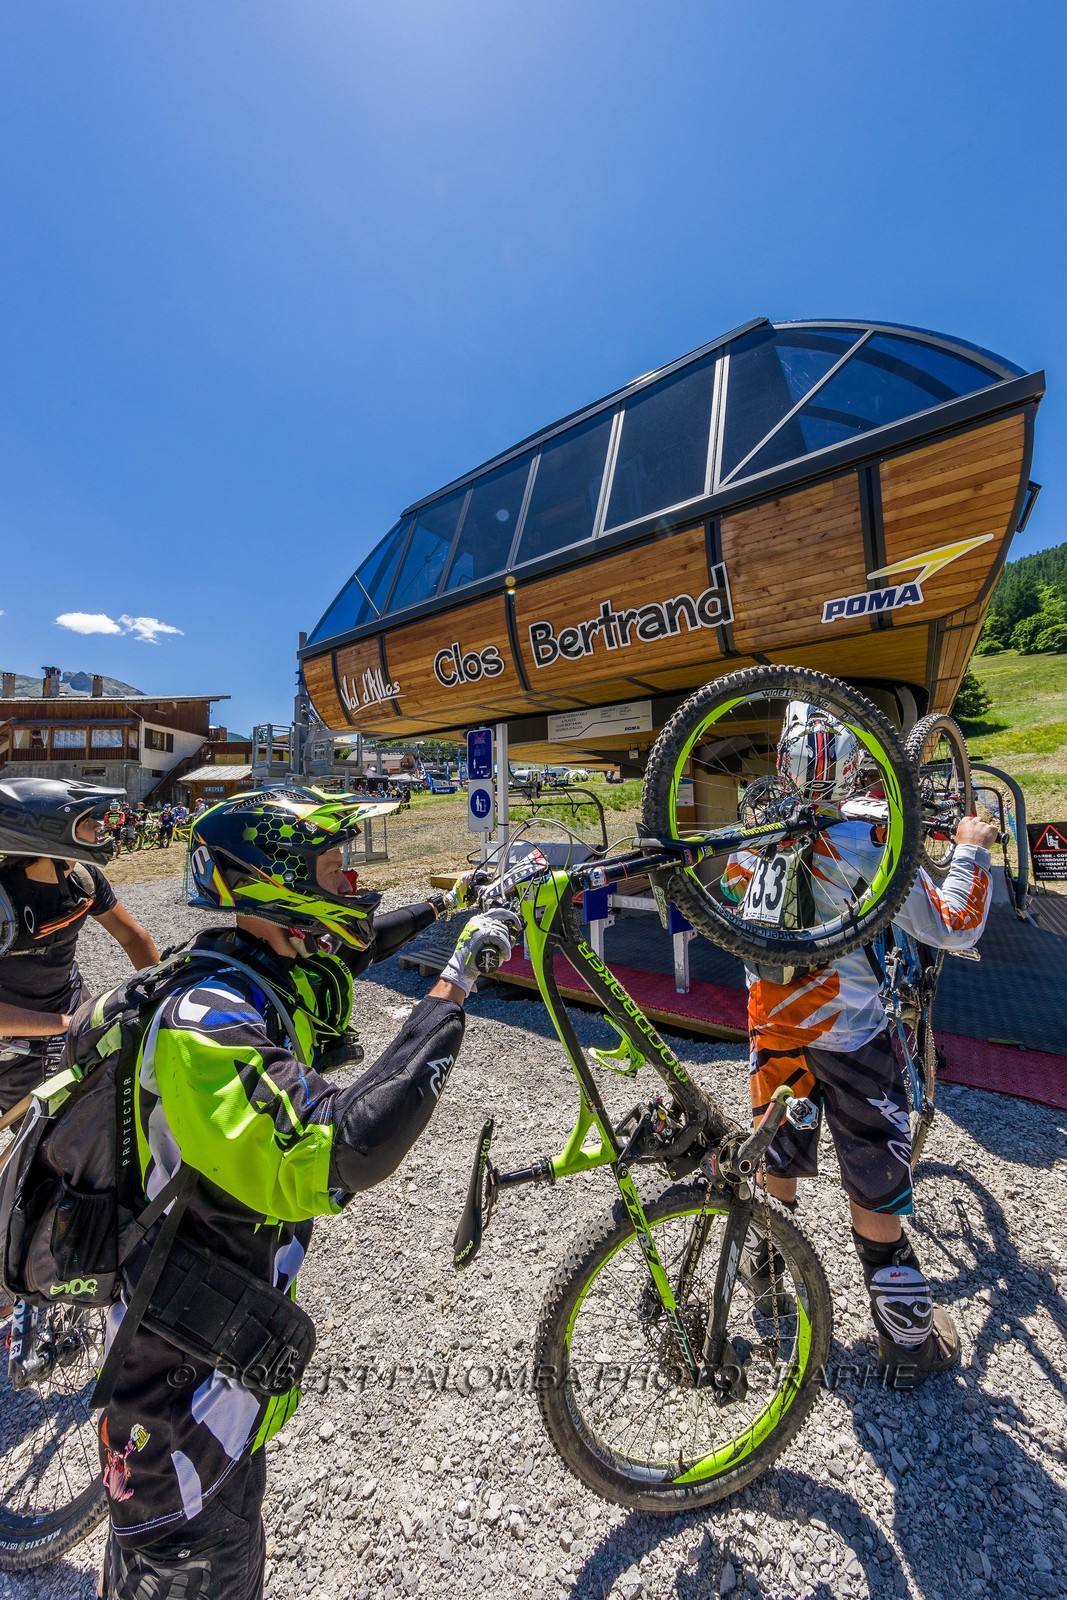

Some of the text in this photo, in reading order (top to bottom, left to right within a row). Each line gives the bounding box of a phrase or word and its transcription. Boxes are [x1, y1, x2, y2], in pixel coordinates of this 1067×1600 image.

[434, 562, 735, 688] Clos Bertrand
[822, 582, 925, 624] POMA
[341, 675, 359, 711] Val
[577, 941, 689, 1083] MONDRAKER
[122, 1076, 132, 1166] PROTECTOR
[24, 1527, 62, 1550] MAXXIS
